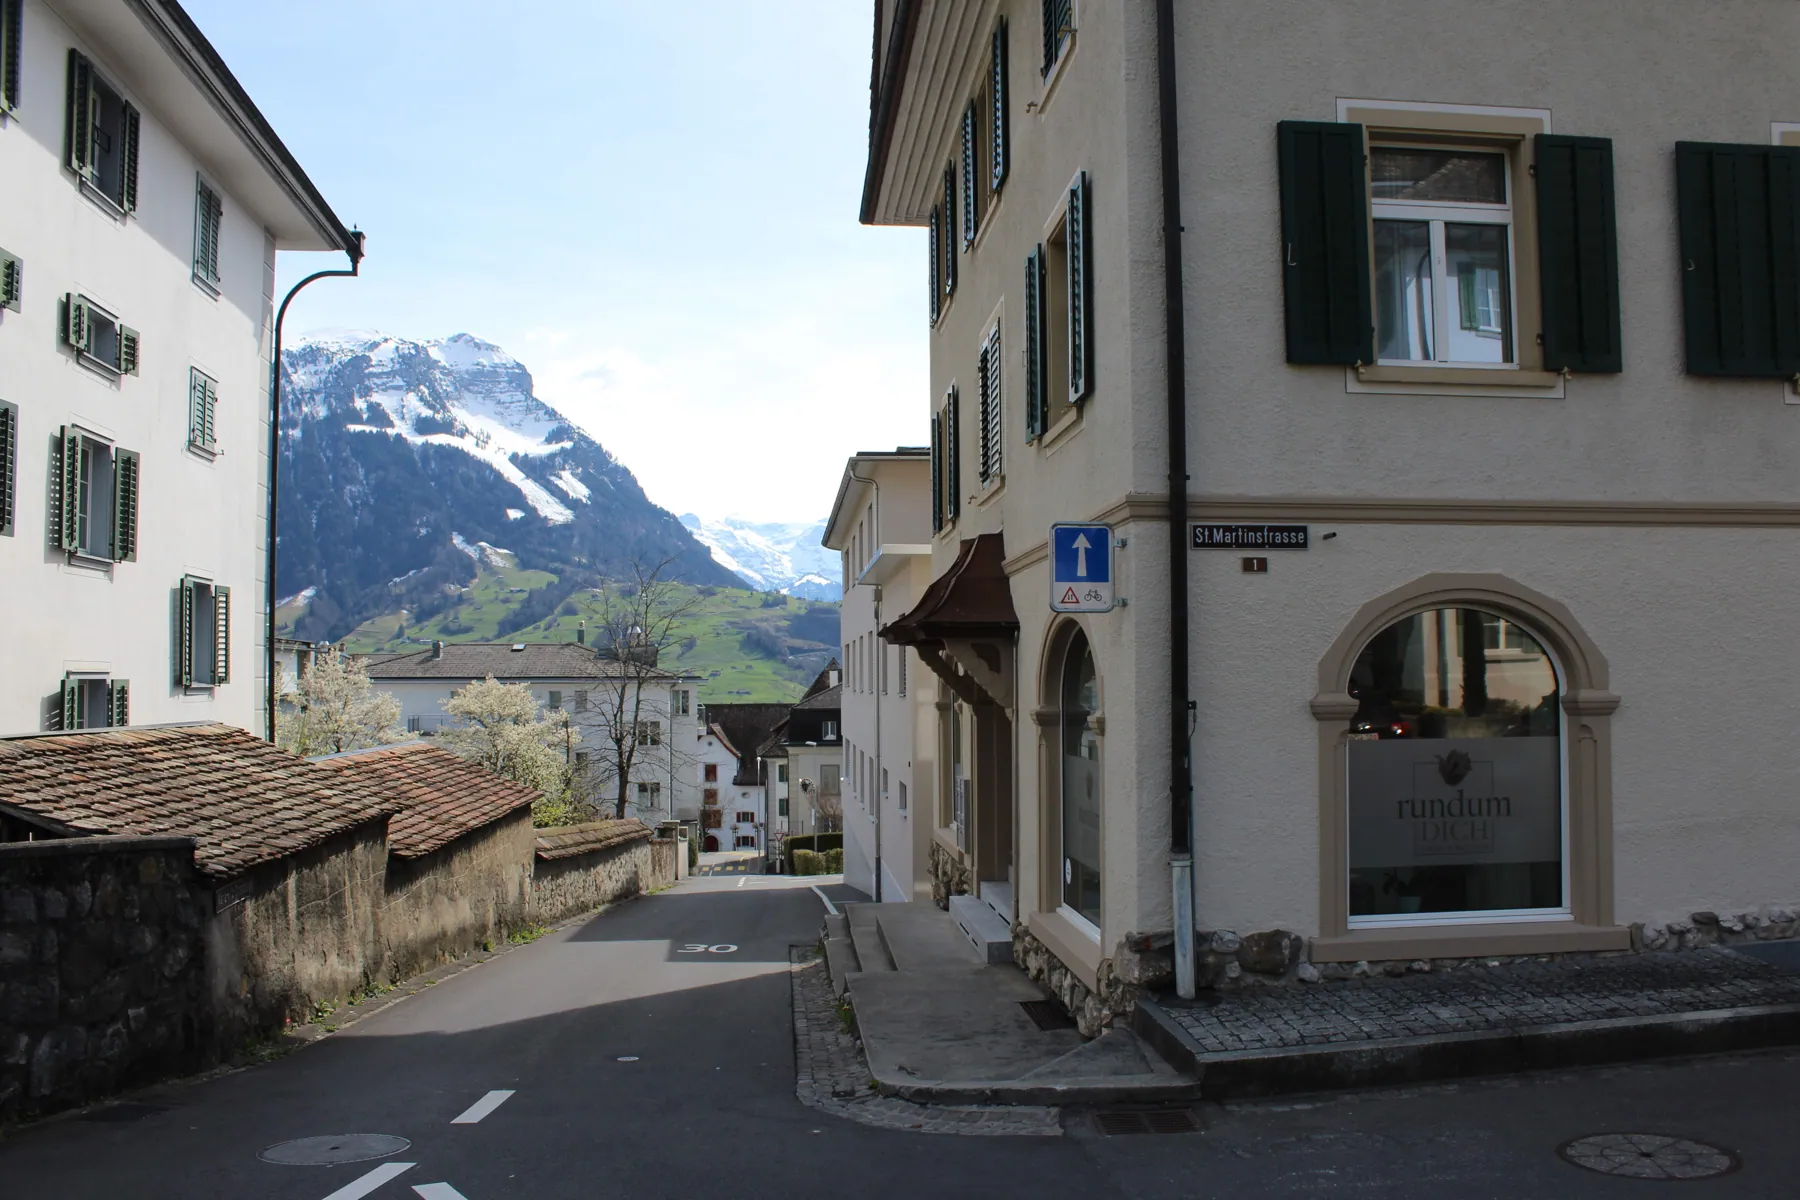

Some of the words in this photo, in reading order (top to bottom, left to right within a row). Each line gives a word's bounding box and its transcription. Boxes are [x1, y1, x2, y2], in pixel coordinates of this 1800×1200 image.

[1252, 559, 1258, 571] 1
[1396, 789, 1511, 819] rundum
[1421, 820, 1489, 841] DICH
[677, 944, 738, 953] 30
